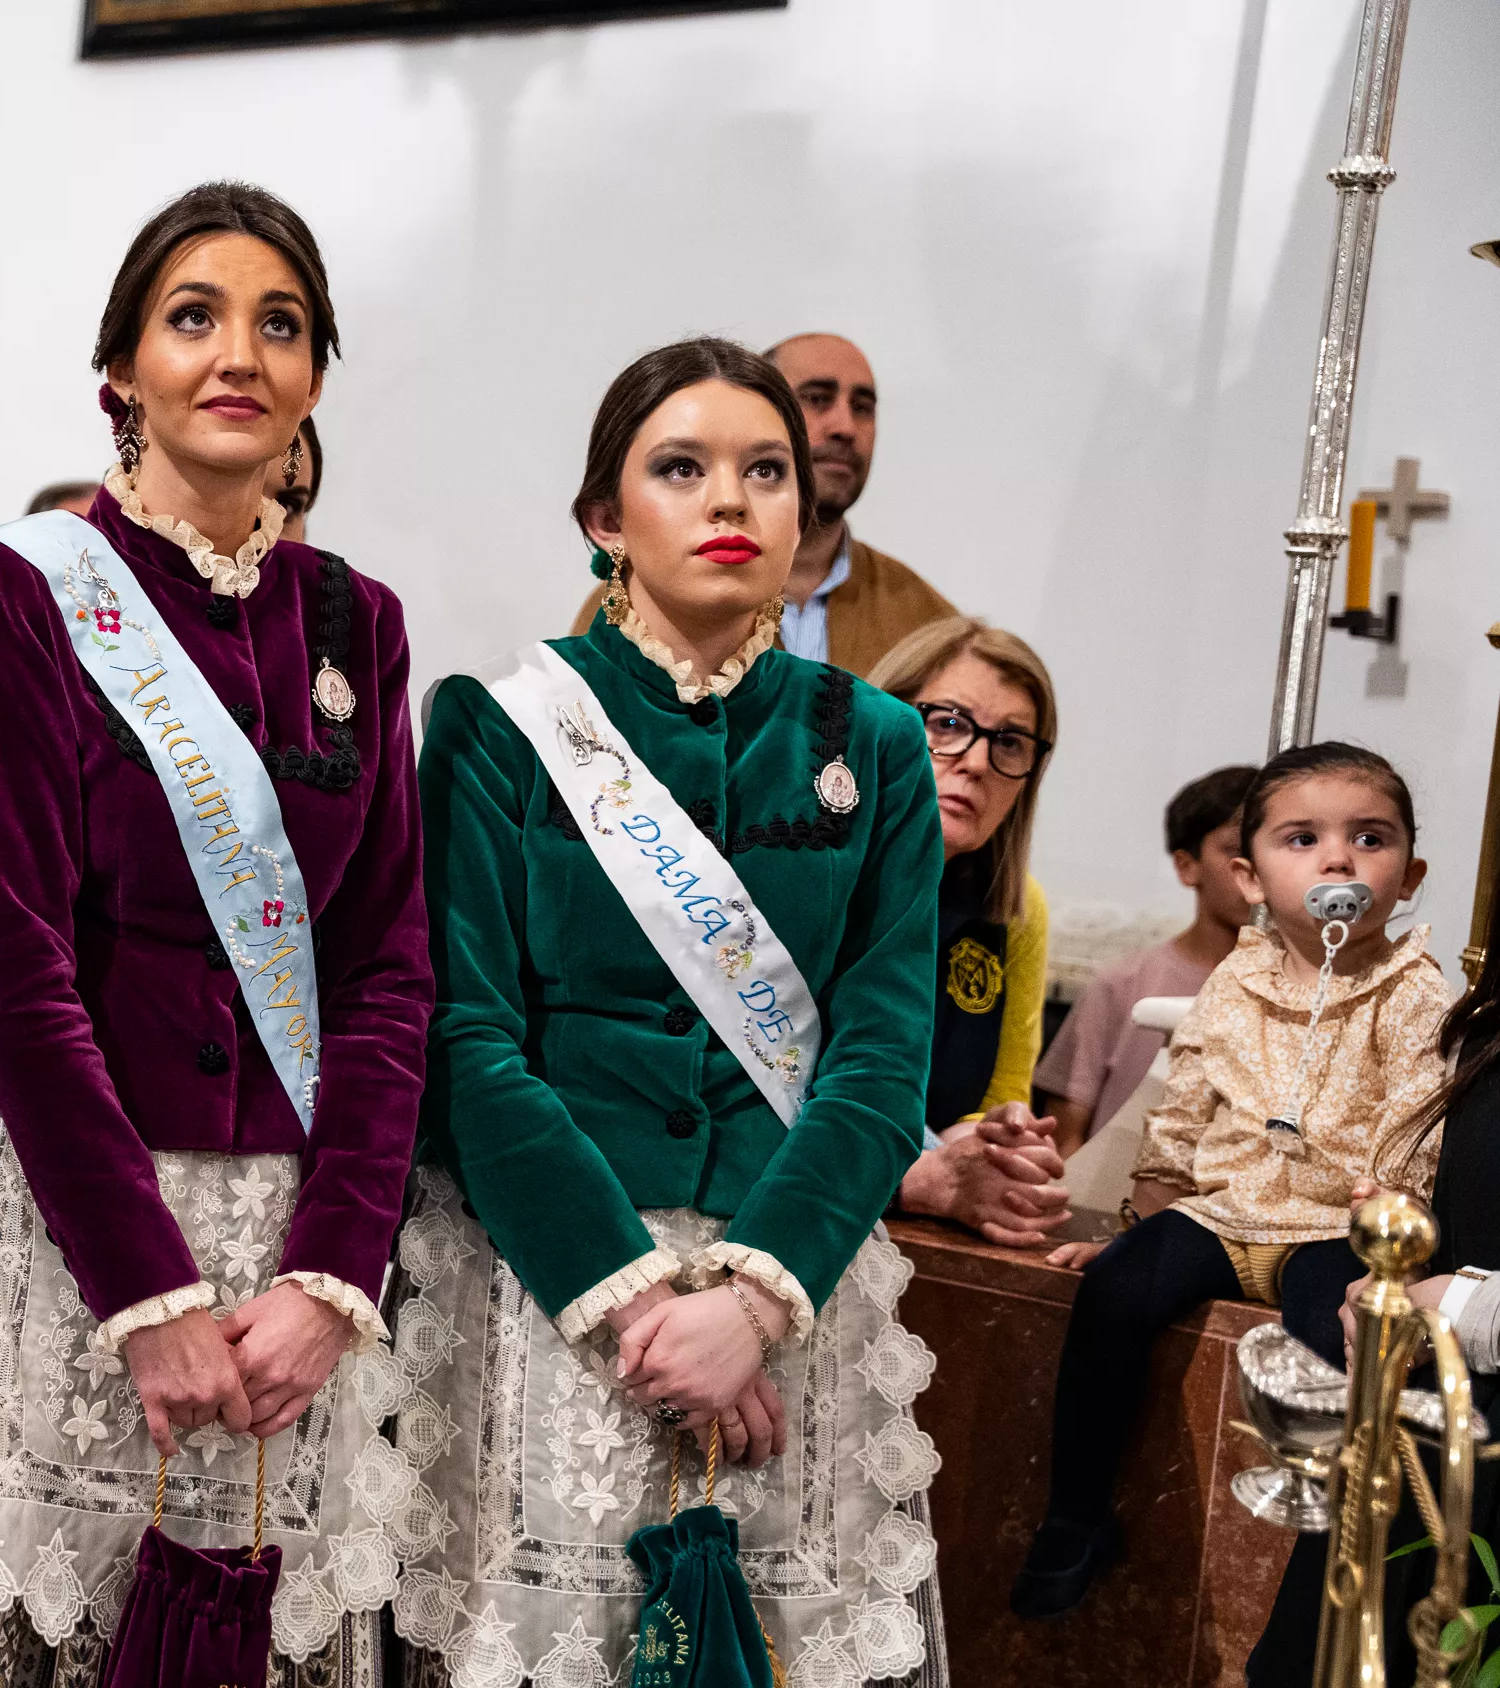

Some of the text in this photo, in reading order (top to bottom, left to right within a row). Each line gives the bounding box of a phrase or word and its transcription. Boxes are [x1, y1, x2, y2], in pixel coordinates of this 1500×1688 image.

[620, 814, 794, 1043] DAMA DE
[654, 1598, 690, 1665] ELITANA
